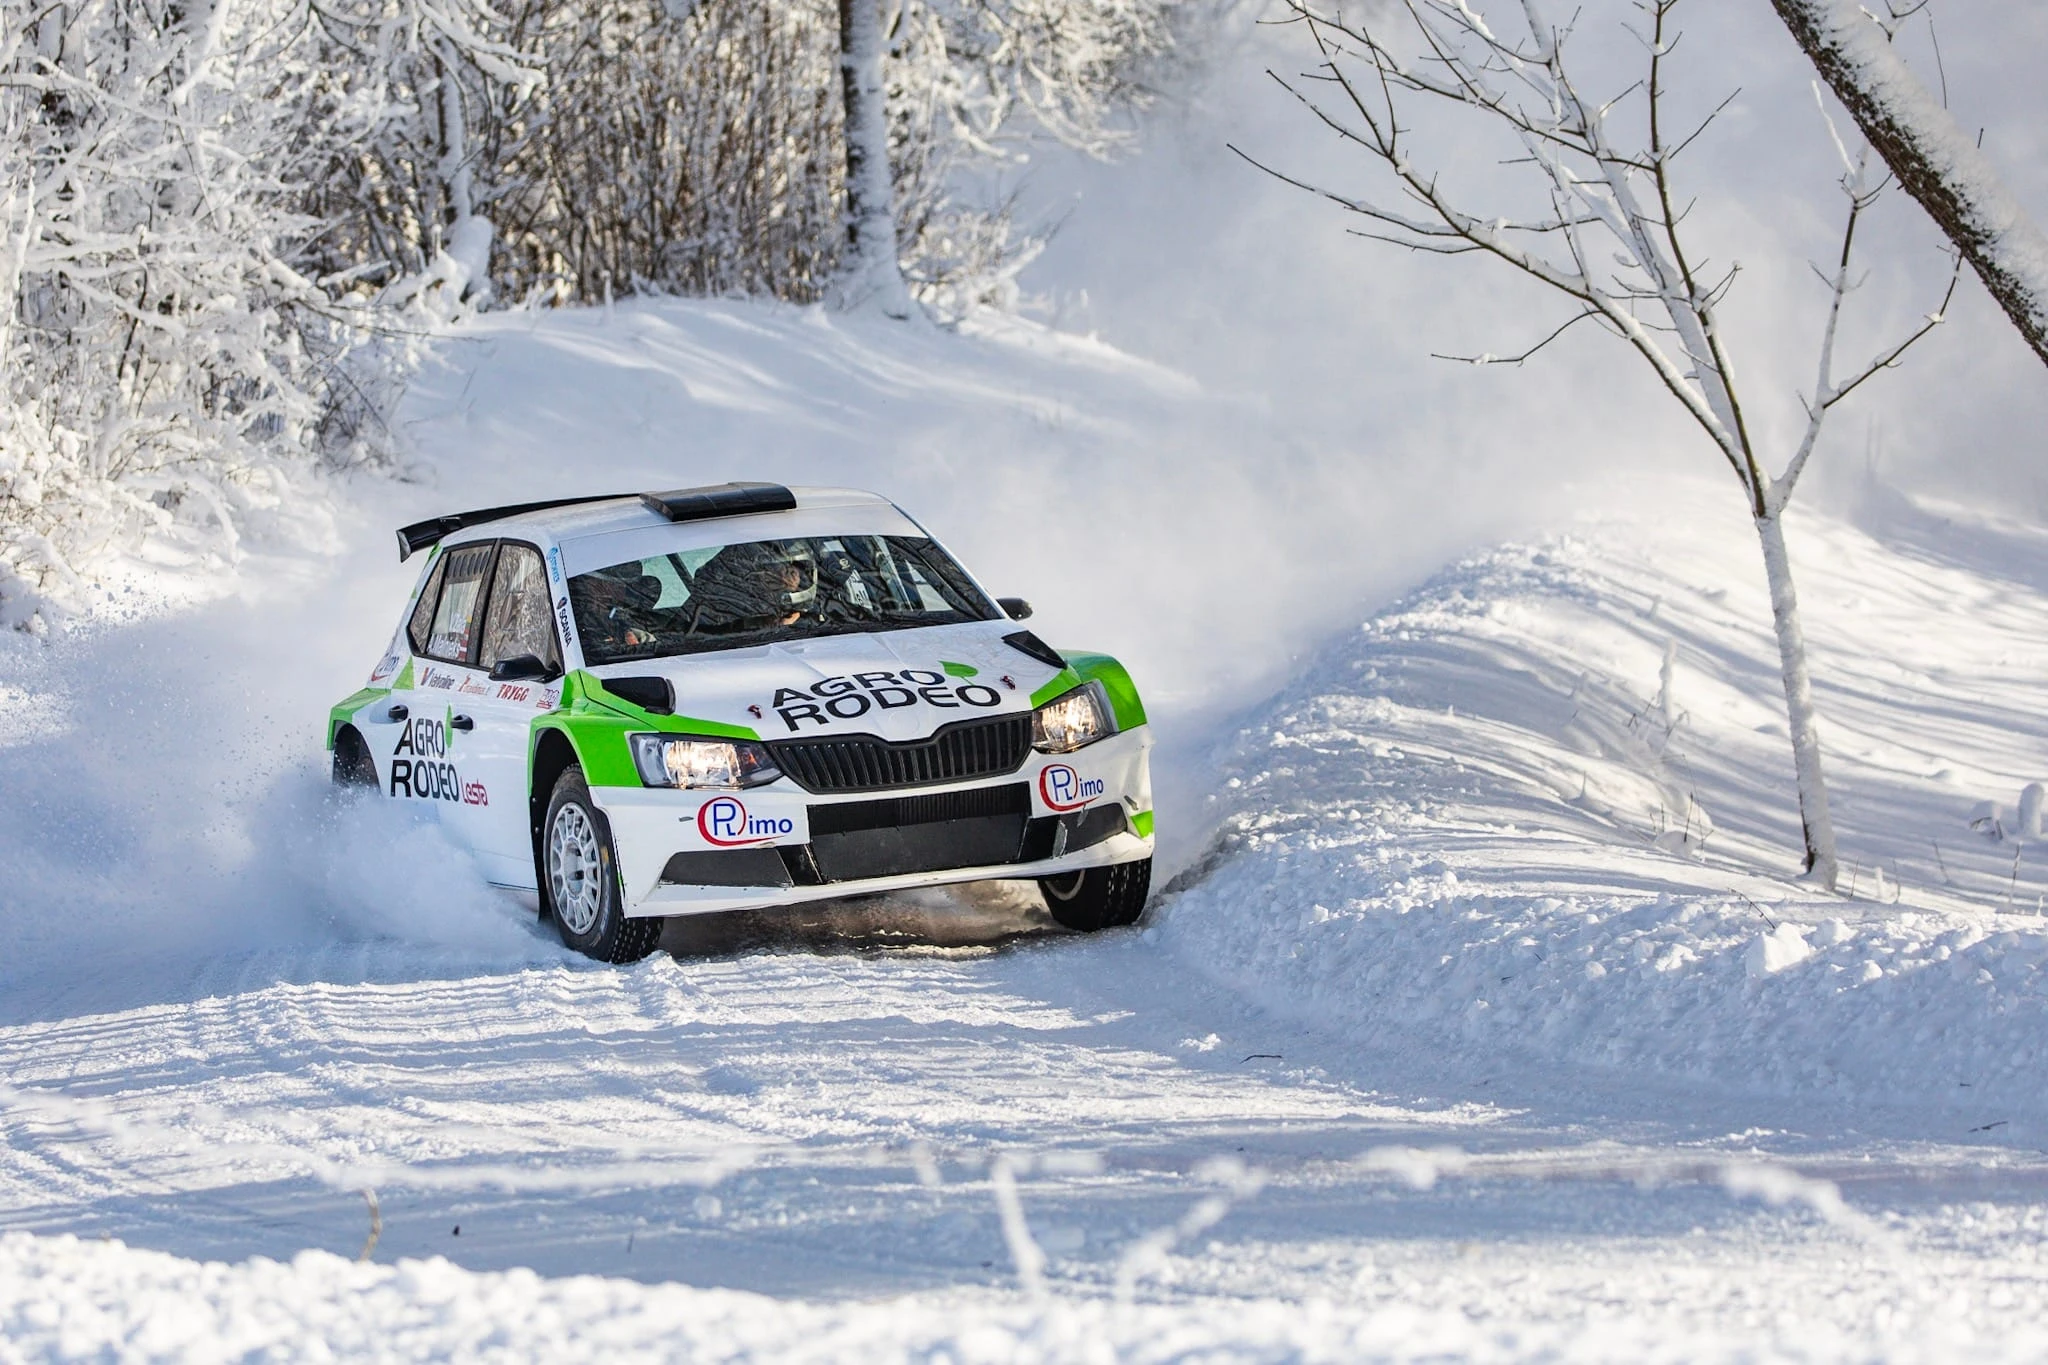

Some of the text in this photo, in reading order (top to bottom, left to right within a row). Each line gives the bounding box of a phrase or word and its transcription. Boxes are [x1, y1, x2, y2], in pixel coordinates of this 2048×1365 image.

[560, 608, 572, 648] SCANIA
[496, 684, 530, 702] TRYGG
[773, 669, 945, 708] AGRO
[776, 685, 1002, 732] RODEO
[393, 718, 445, 758] AGRO
[390, 760, 459, 802] RODEO
